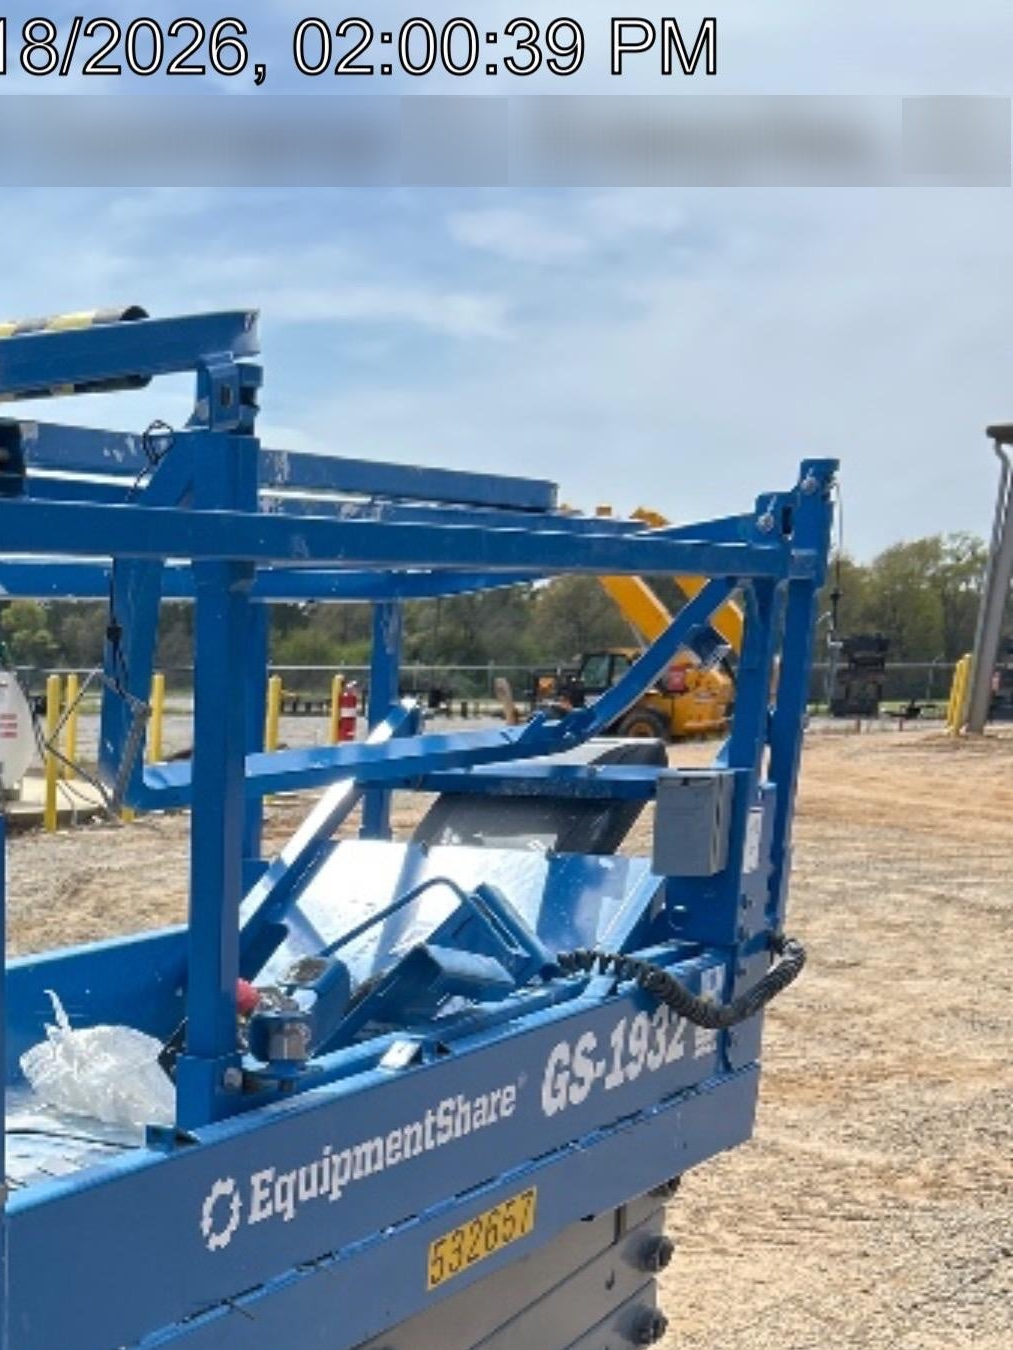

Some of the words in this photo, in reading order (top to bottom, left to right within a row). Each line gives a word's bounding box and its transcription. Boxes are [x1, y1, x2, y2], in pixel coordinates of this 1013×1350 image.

[541, 1002, 688, 1117] GS-1932
[247, 1082, 517, 1225] EquipmentShare
[431, 1190, 534, 1285] 532657
